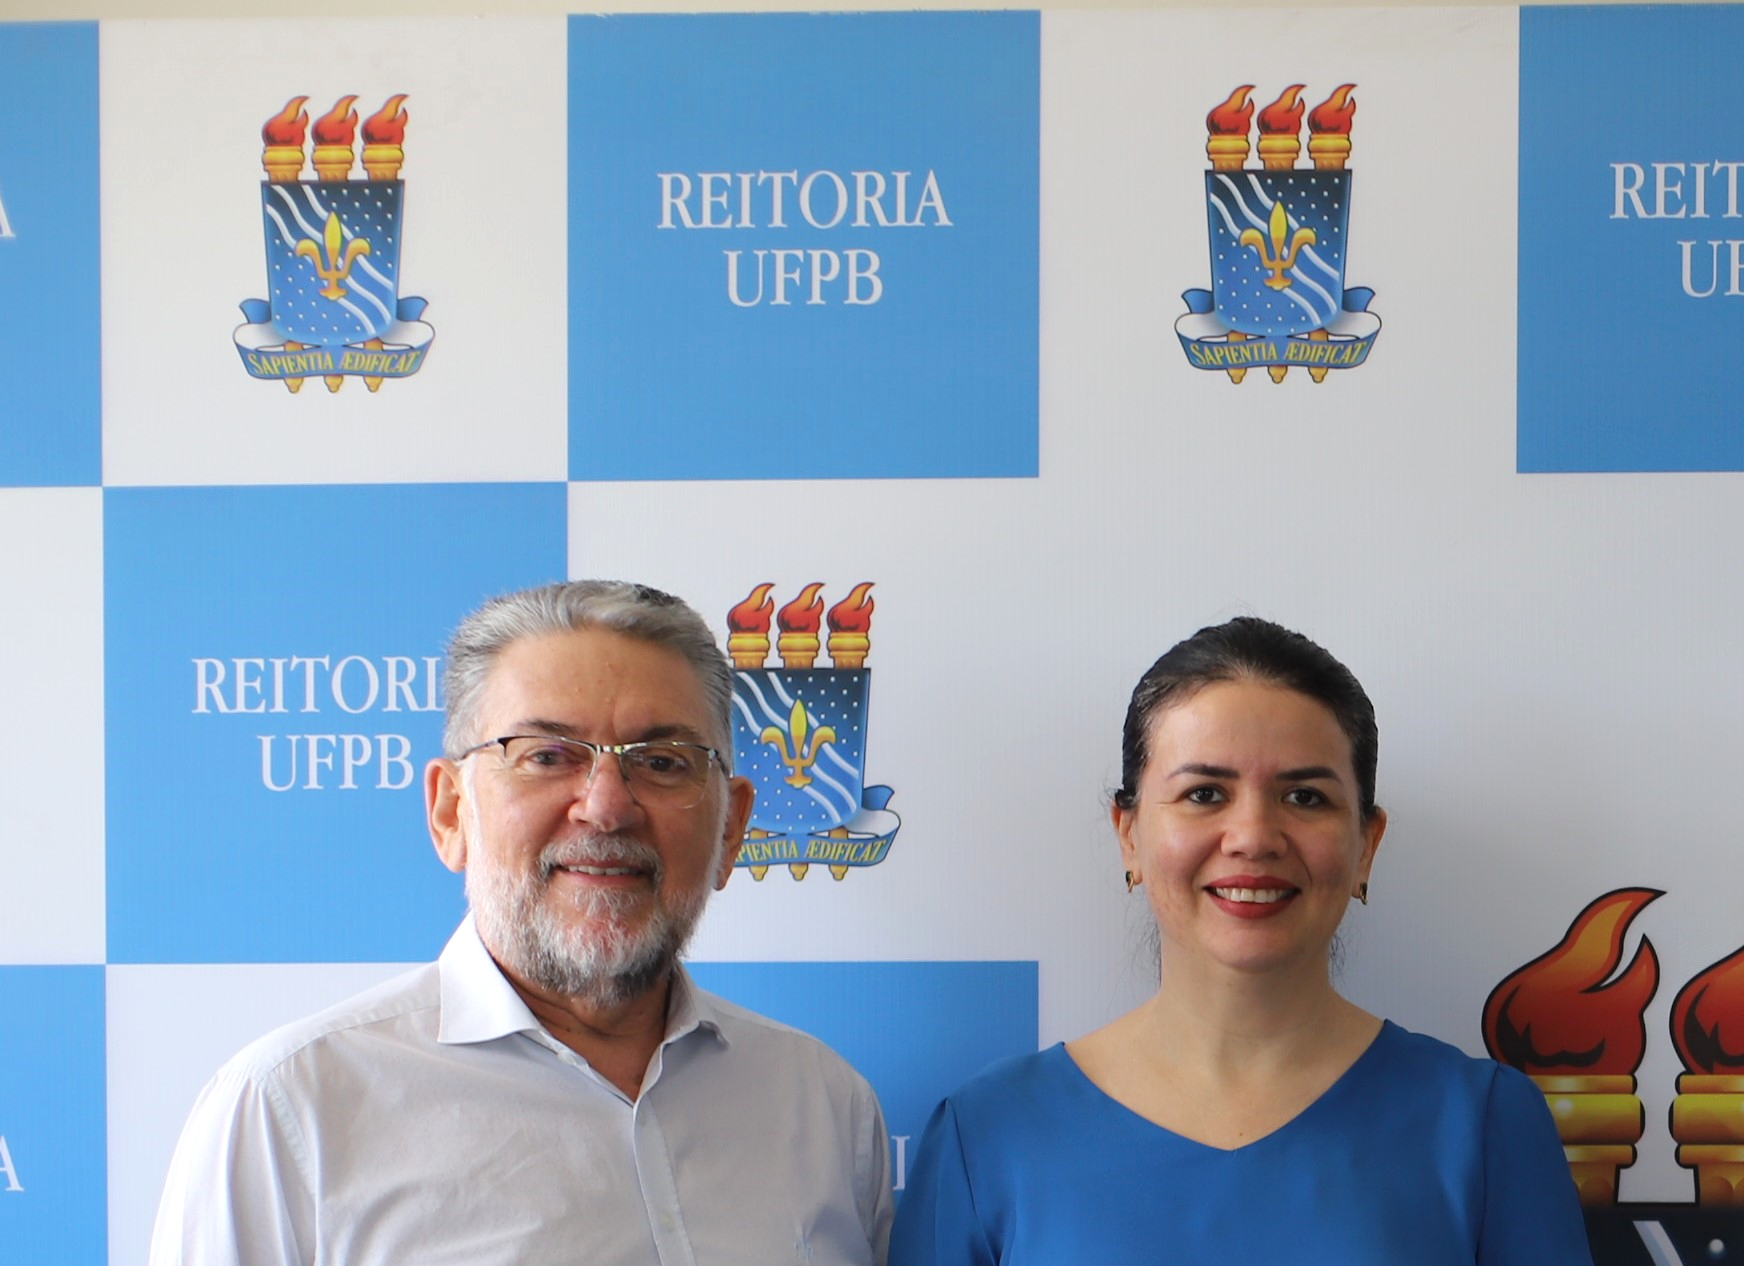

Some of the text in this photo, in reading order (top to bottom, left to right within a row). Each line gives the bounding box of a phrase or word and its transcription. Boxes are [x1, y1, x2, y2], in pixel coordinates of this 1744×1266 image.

[657, 169, 953, 229] REITORIA
[723, 248, 883, 307] UFPB
[247, 351, 334, 375] SAPIENTIA
[1190, 342, 1279, 365] SAPIENTIA
[191, 655, 446, 714] REITORI
[257, 733, 414, 792] UFPB
[736, 839, 798, 863] PIENTIA
